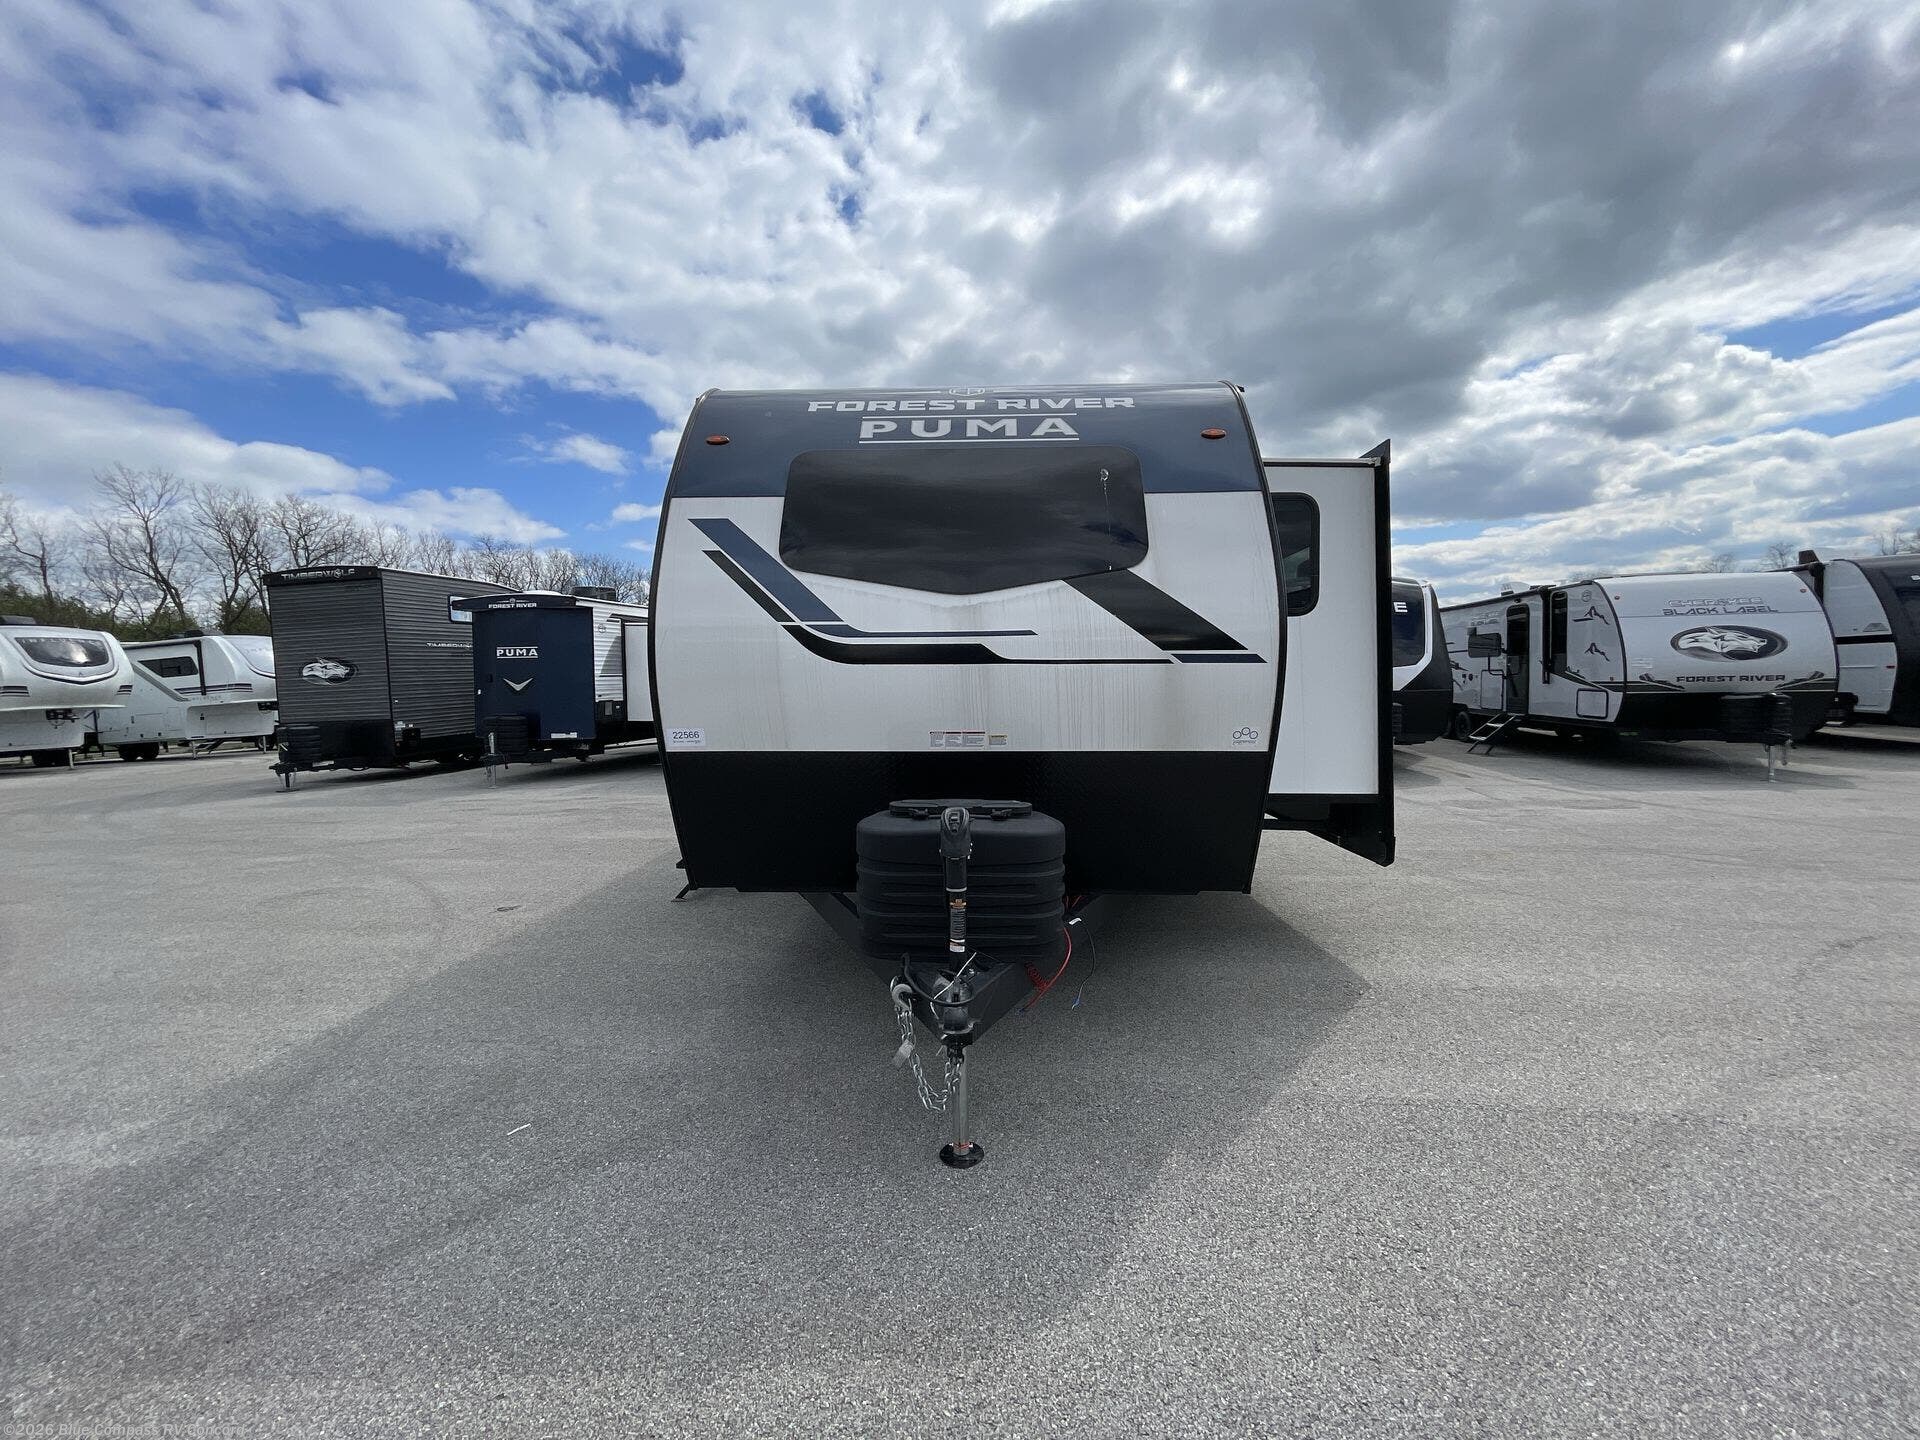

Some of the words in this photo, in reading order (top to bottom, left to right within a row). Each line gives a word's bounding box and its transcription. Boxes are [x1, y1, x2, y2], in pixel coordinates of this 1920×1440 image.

[807, 399, 986, 412] FOREST
[996, 397, 1135, 410] RIVER
[859, 417, 1079, 438] PUMA
[1662, 607, 1719, 616] BLACK
[1722, 605, 1779, 614] LABEL
[496, 648, 538, 657] PUMA
[1676, 675, 1736, 683] FOREST
[1739, 674, 1786, 682] RIVER
[672, 731, 700, 739] 22566
